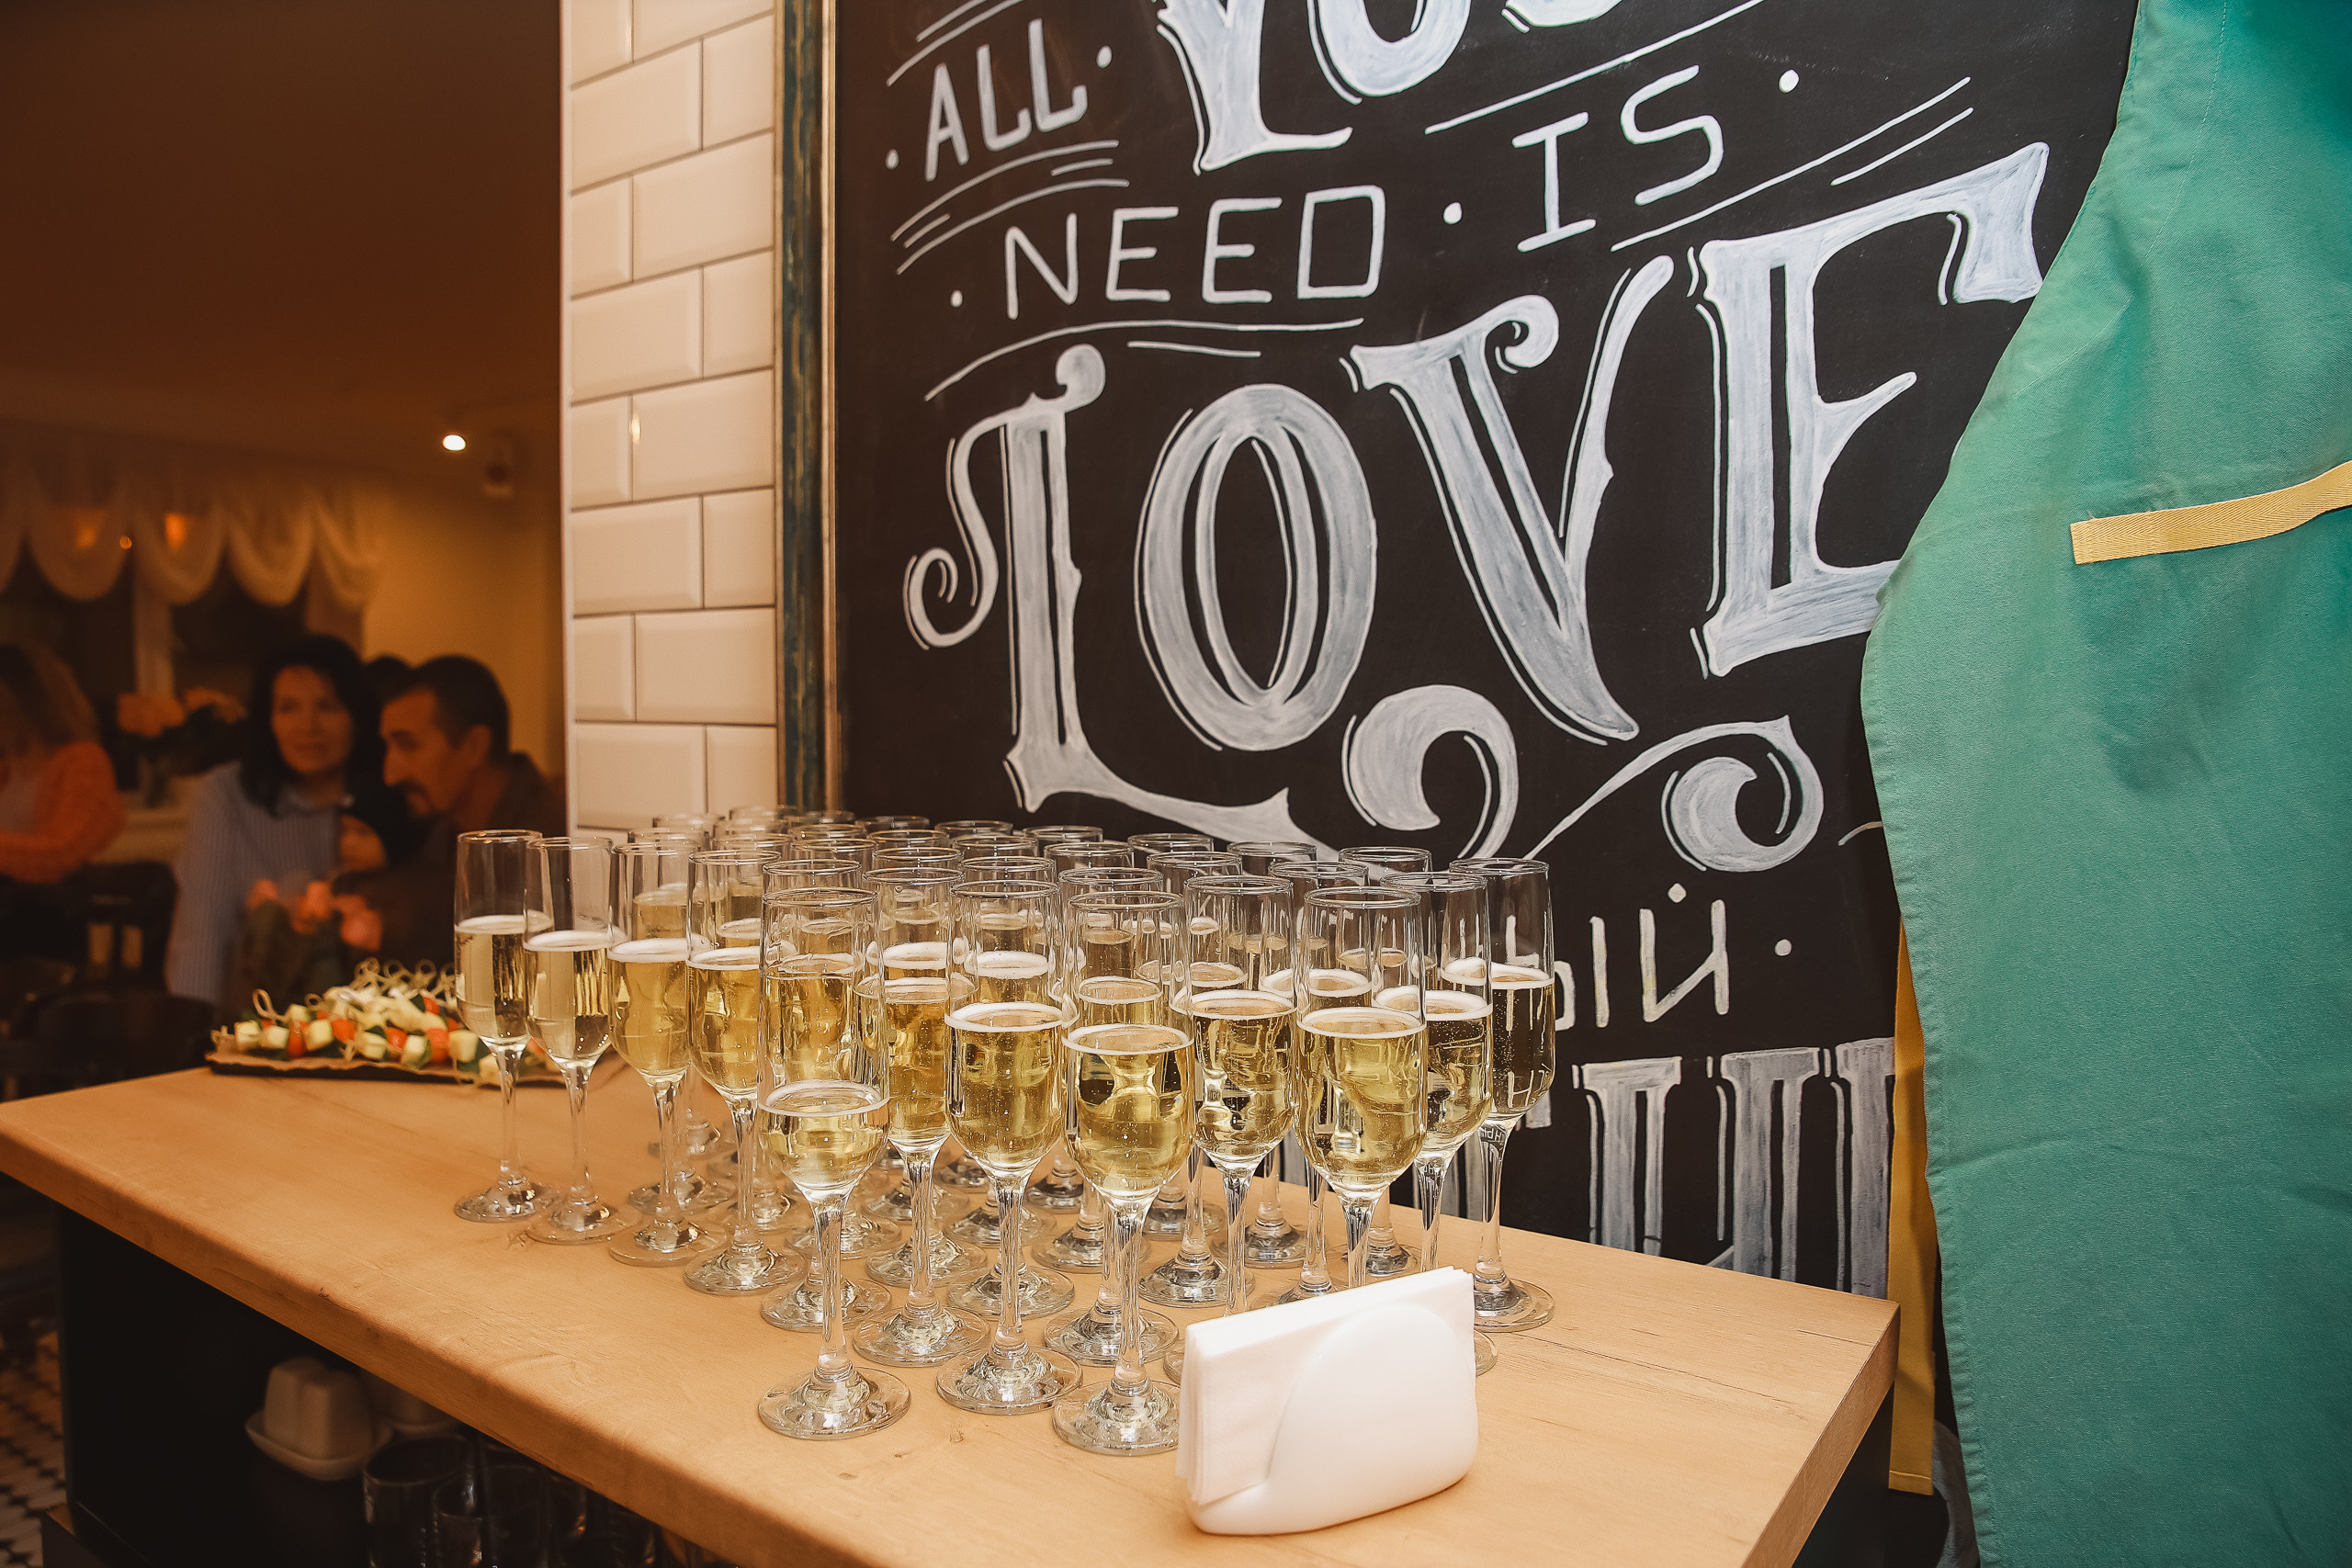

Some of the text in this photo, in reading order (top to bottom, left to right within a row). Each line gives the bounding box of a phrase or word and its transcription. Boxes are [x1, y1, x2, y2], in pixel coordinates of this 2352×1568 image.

[924, 17, 1089, 183] ALL
[1005, 63, 1725, 321] NEED IS
[903, 141, 2050, 850] LOVE
